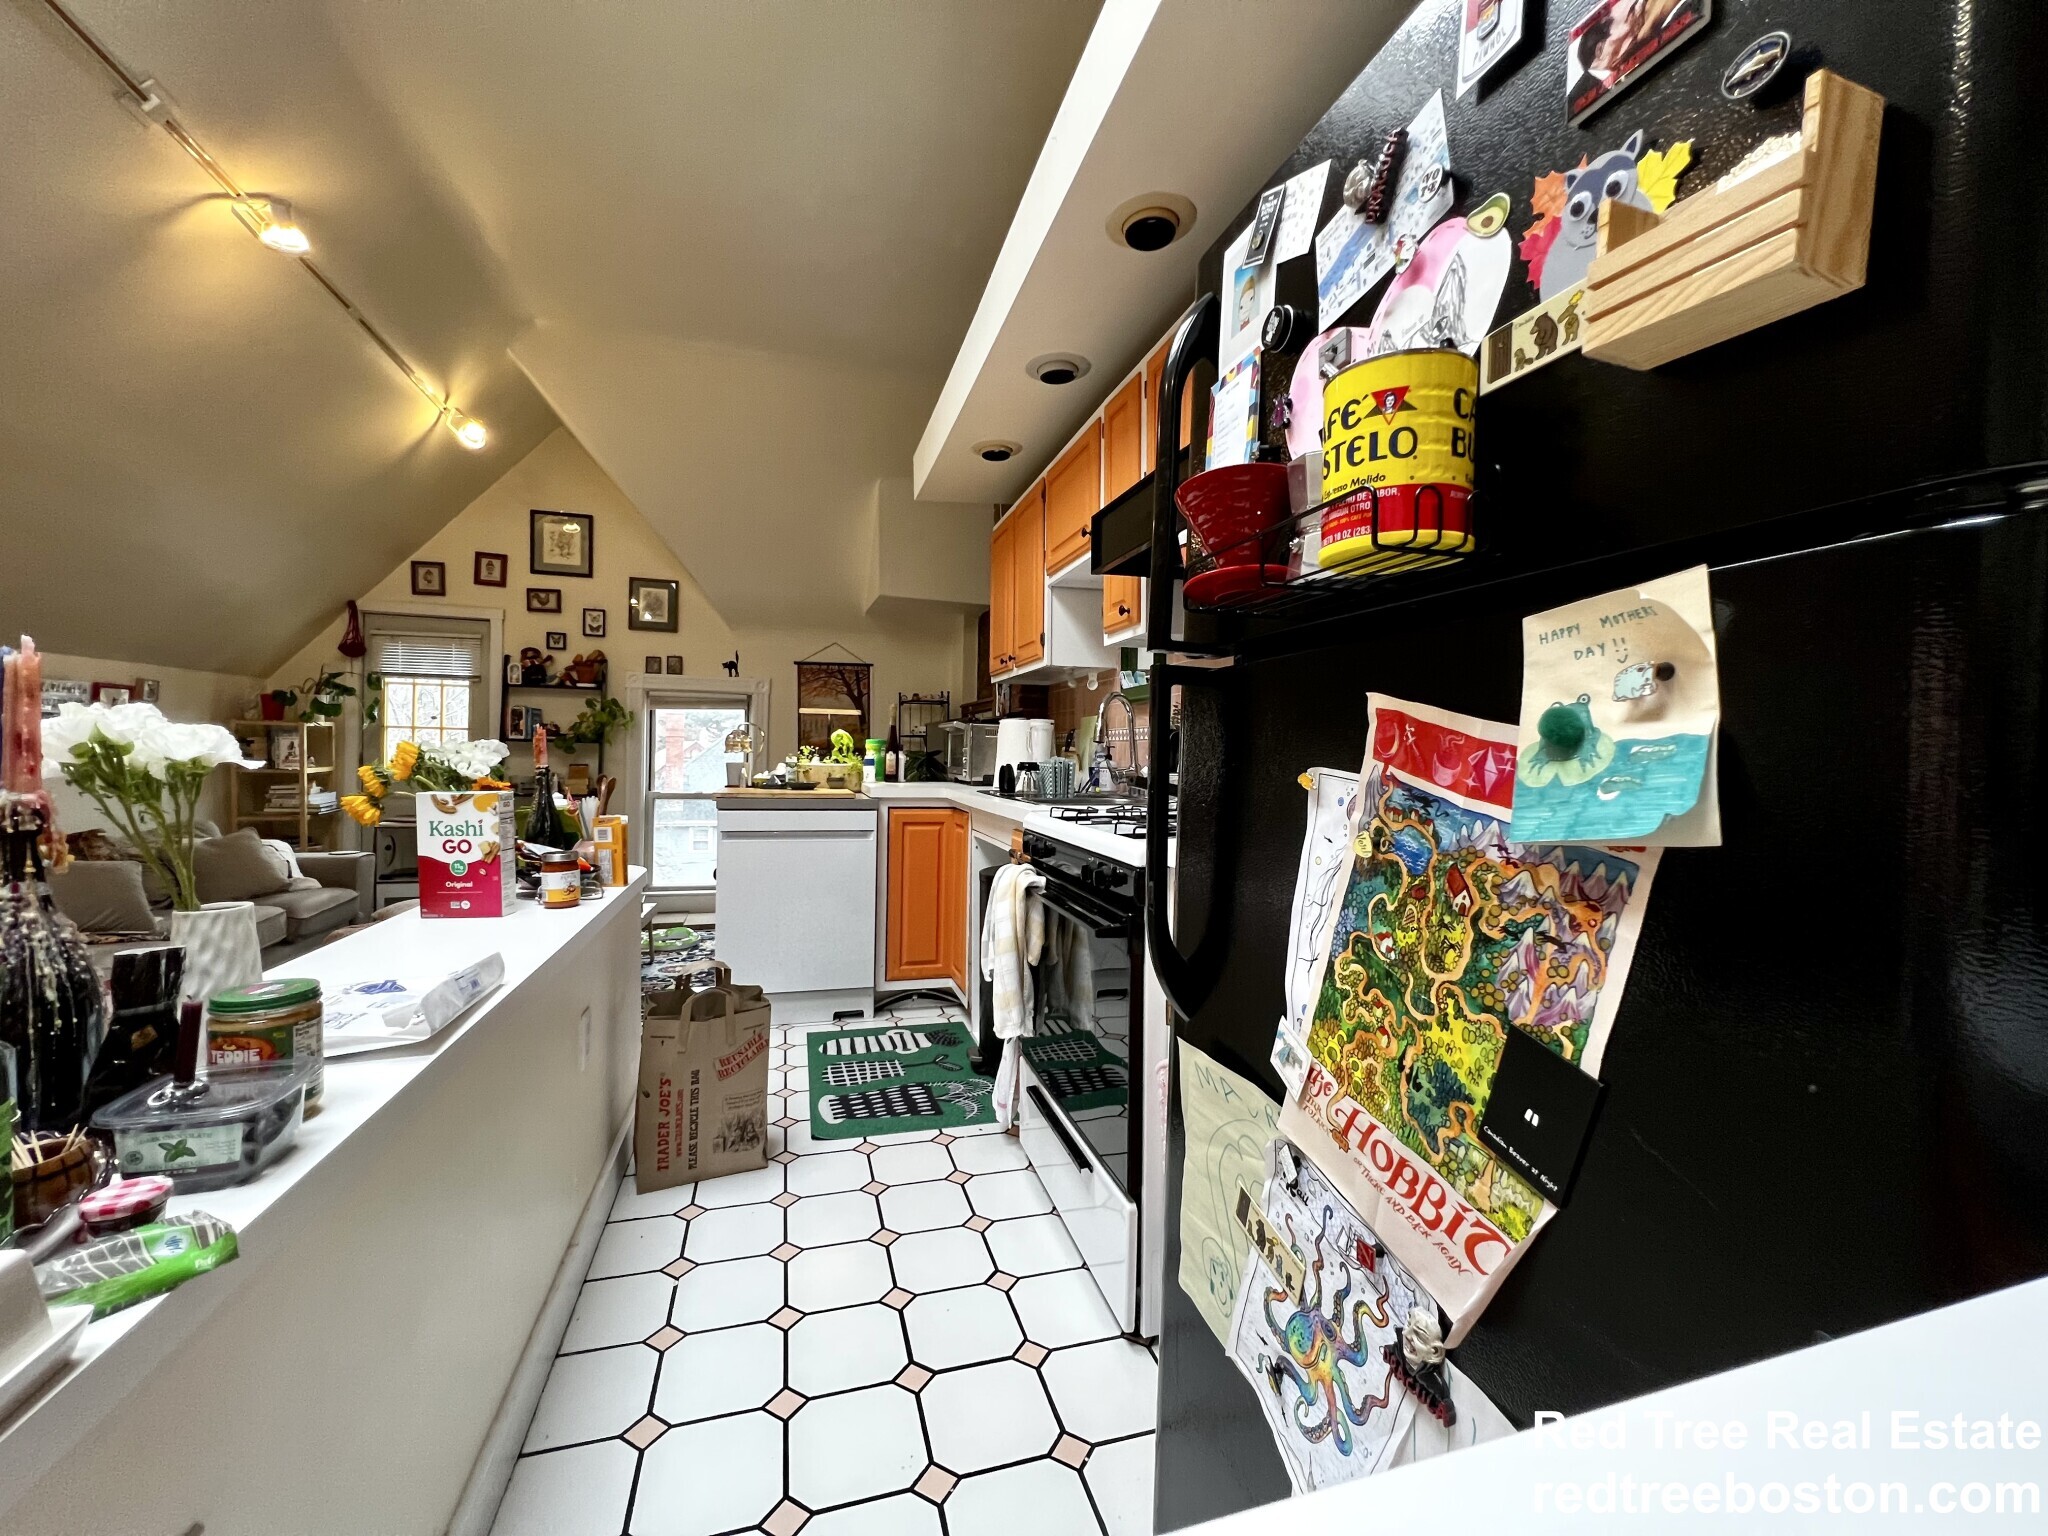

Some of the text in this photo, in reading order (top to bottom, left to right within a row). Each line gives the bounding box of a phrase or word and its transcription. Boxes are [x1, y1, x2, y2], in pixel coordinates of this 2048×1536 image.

[1350, 473, 1386, 489] Molido
[1342, 528, 1352, 539] OZ
[1538, 622, 1581, 645] HAPPY
[429, 819, 484, 837] Kashi
[442, 839, 473, 854] GO
[445, 881, 473, 889] Original
[211, 1048, 260, 1064] TEDDIE
[718, 1032, 764, 1068] REUSABLE
[657, 1077, 671, 1172] TRADER JOE'S
[688, 1069, 700, 1170] PLEASE RECYCLE THIS BAG
[1432, 1240, 1472, 1276] AGAIN
